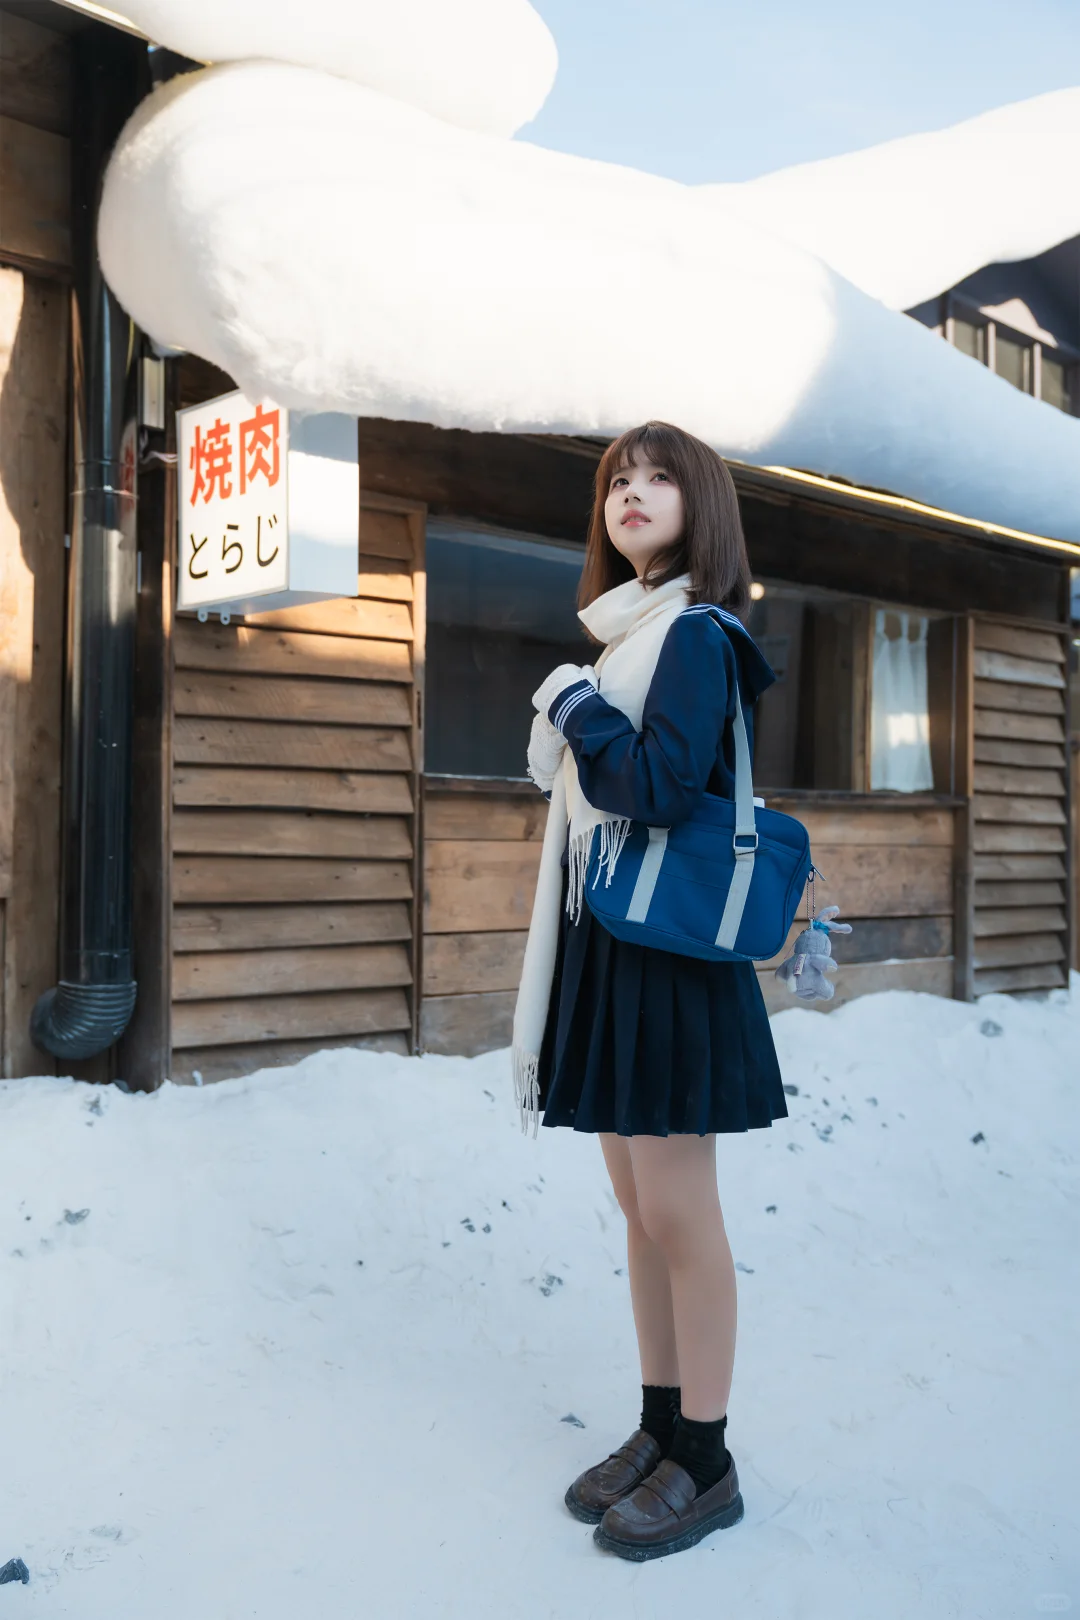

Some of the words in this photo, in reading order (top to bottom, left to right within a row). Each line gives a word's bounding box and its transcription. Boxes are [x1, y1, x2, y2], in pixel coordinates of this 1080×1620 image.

[190, 404, 279, 507] 焼肉
[189, 514, 279, 580] とらじ
